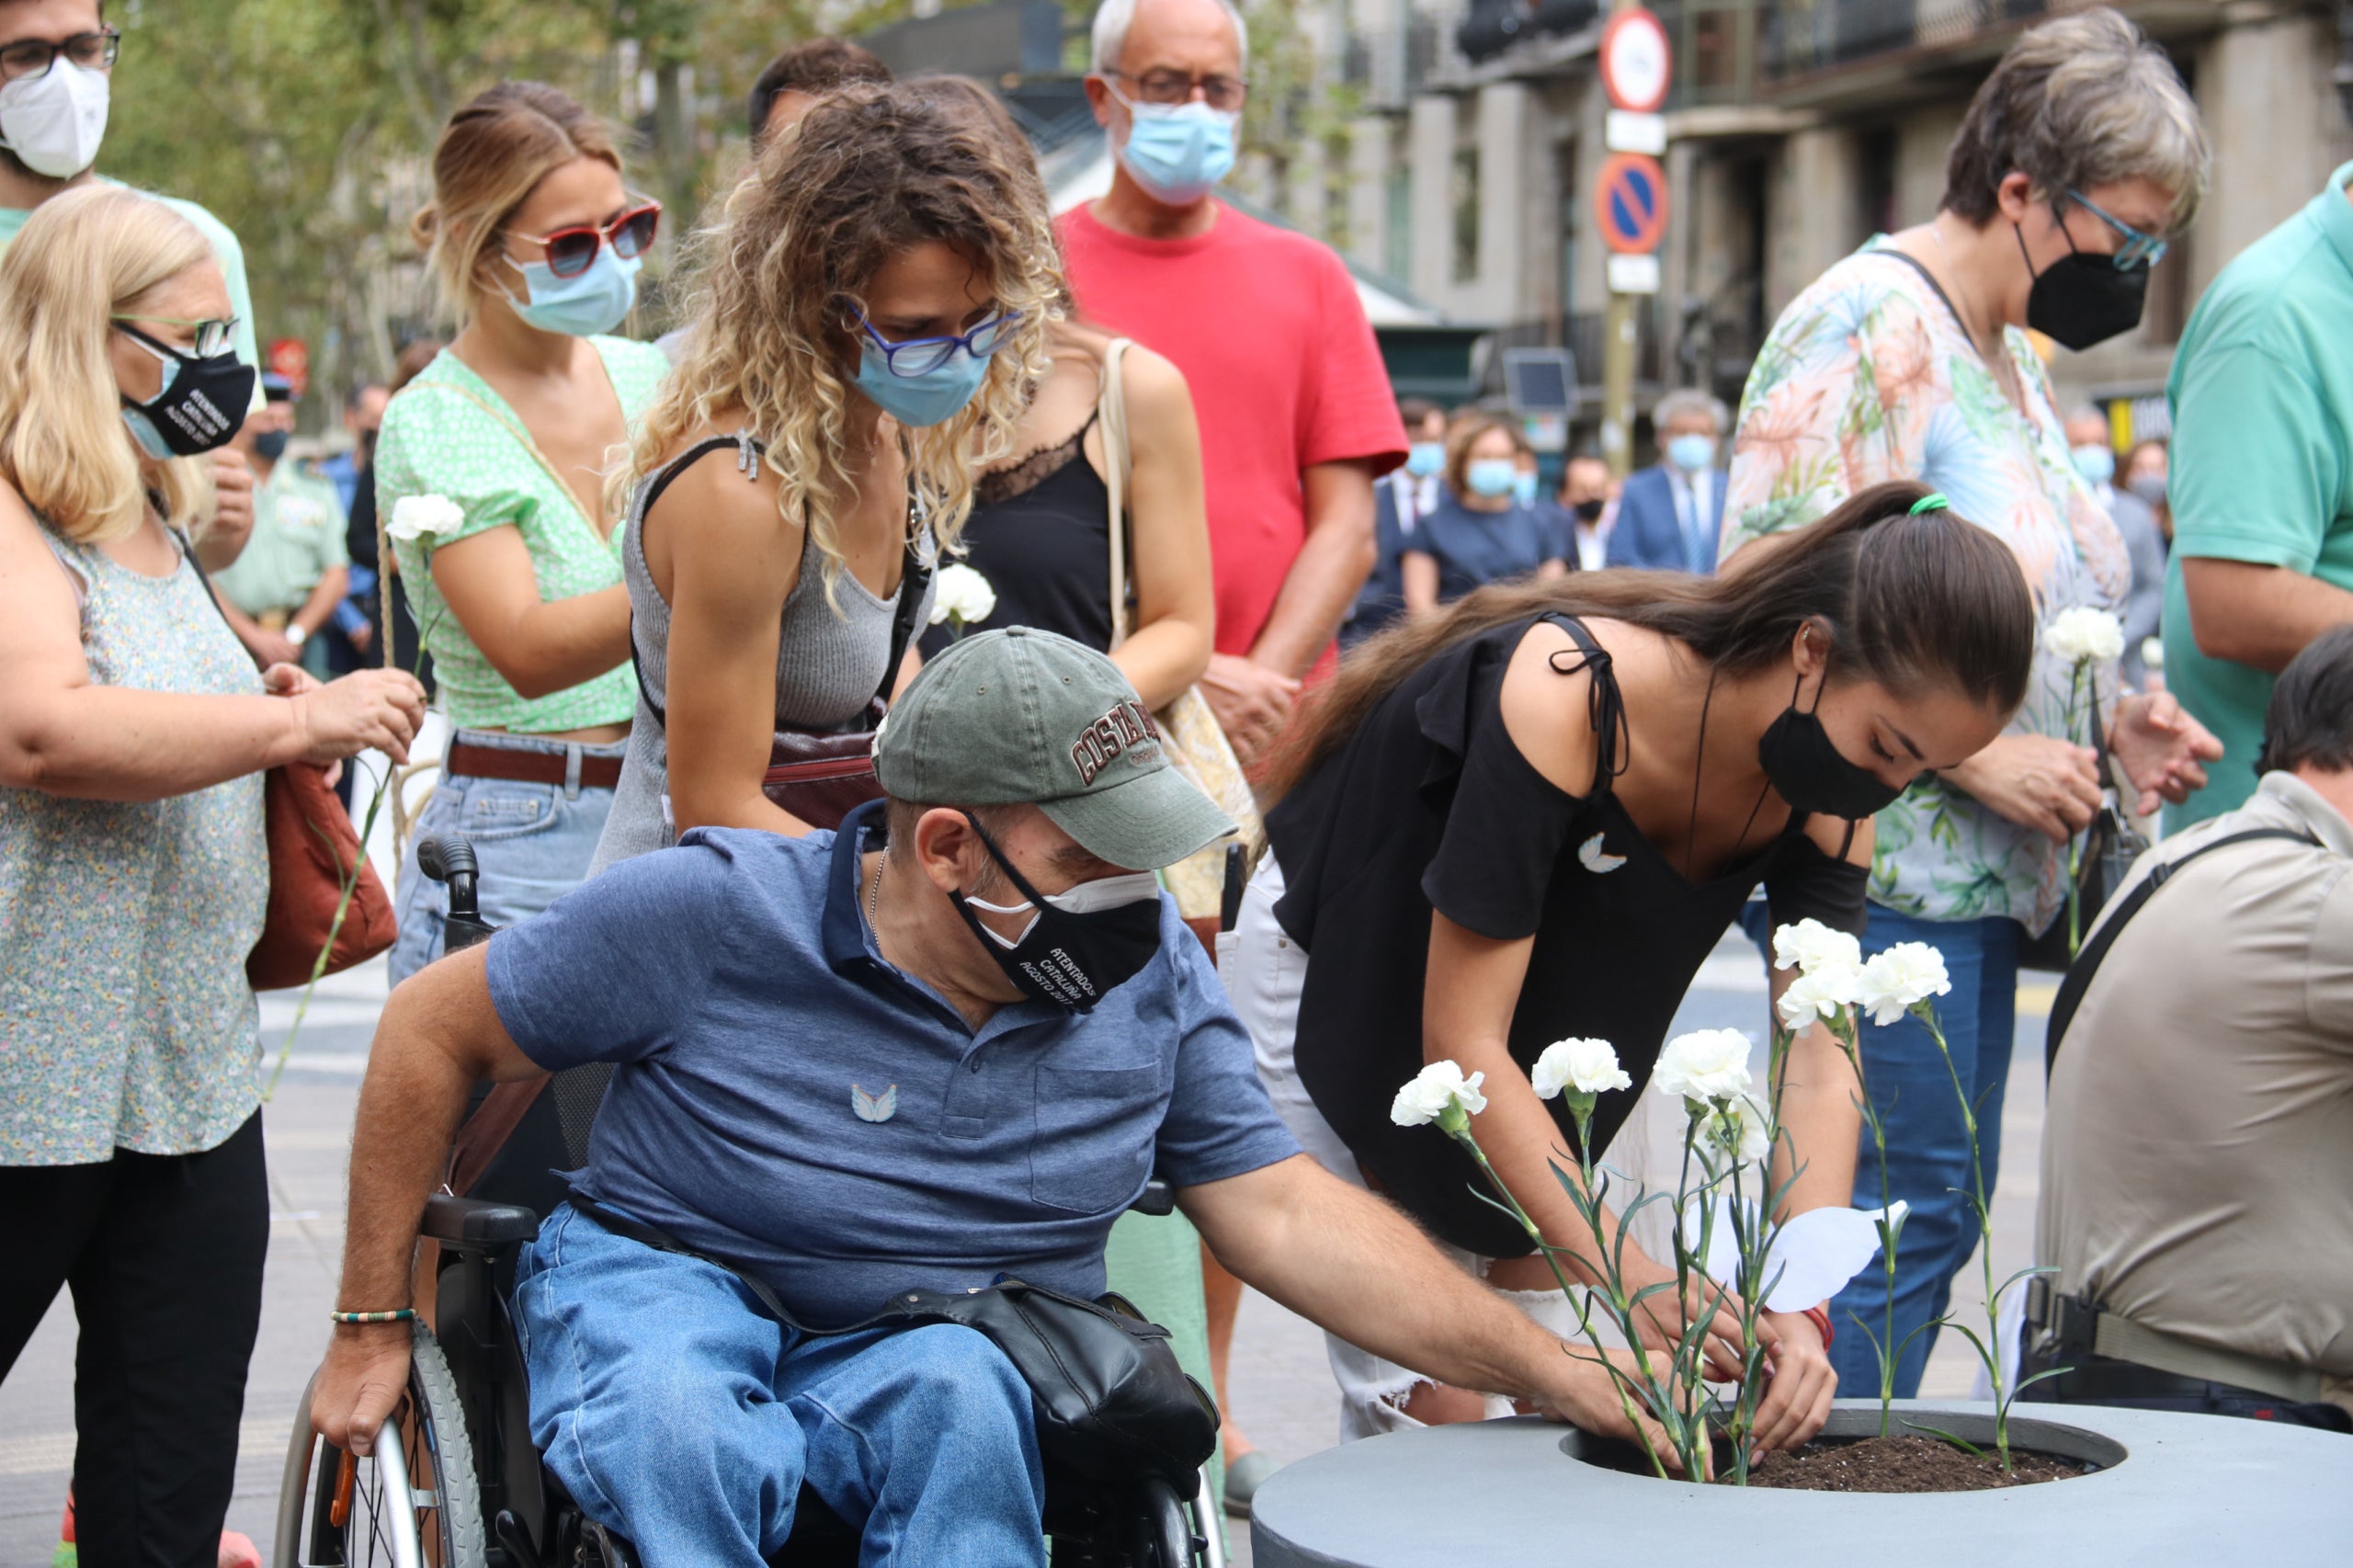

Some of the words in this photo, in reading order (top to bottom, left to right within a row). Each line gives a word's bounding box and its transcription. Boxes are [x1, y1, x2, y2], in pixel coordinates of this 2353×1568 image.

[189, 388, 231, 431] ATENTADOS
[1070, 703, 1143, 787] COSTA
[1019, 961, 1054, 991] AGOSTO
[1050, 991, 1074, 1005] 2017
[1040, 960, 1082, 1000] CATALUÑA
[1050, 948, 1097, 997] ATENTADOS
